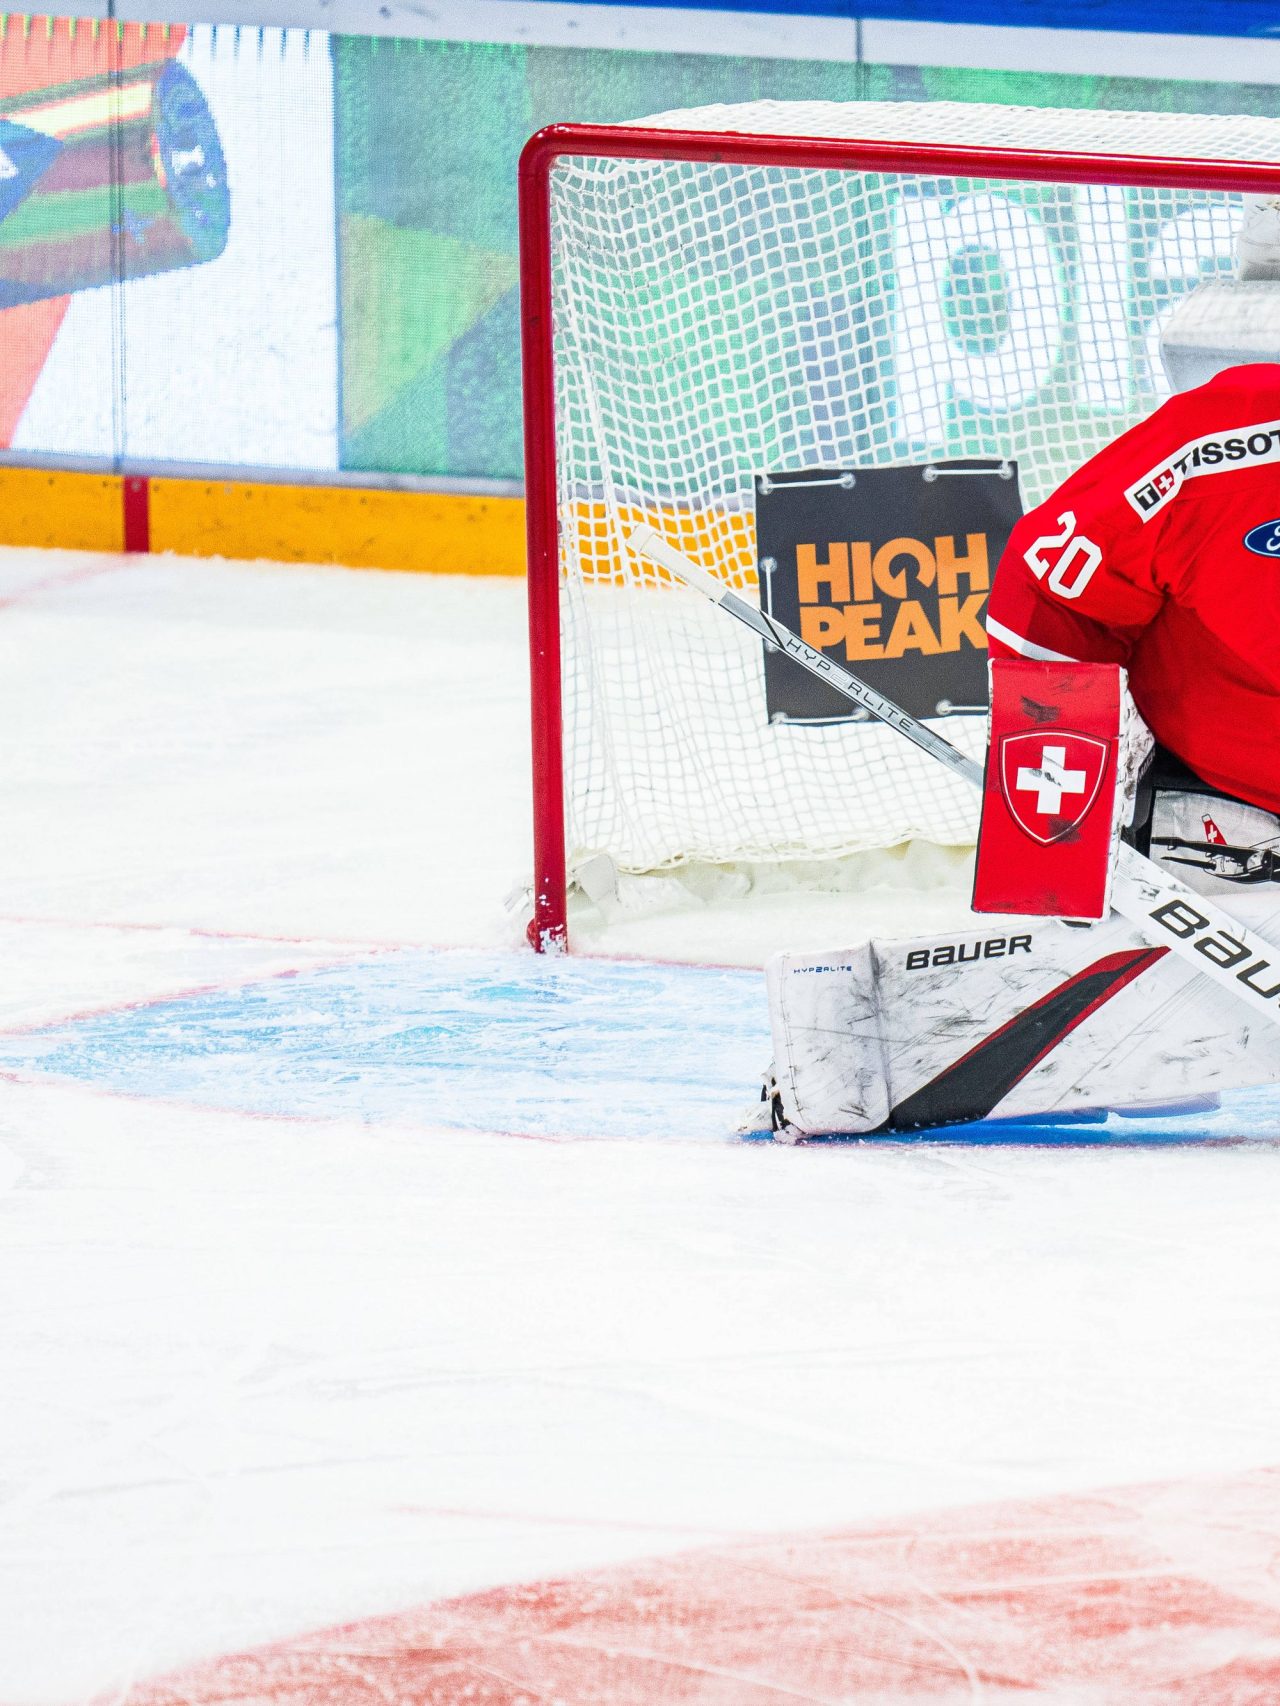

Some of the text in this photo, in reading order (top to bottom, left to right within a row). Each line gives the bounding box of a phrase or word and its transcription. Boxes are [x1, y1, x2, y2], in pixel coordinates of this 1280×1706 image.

[797, 532, 989, 604] HIGH
[1023, 510, 1103, 600] 20
[799, 592, 989, 661] PEAK
[906, 934, 1032, 971] BAUER
